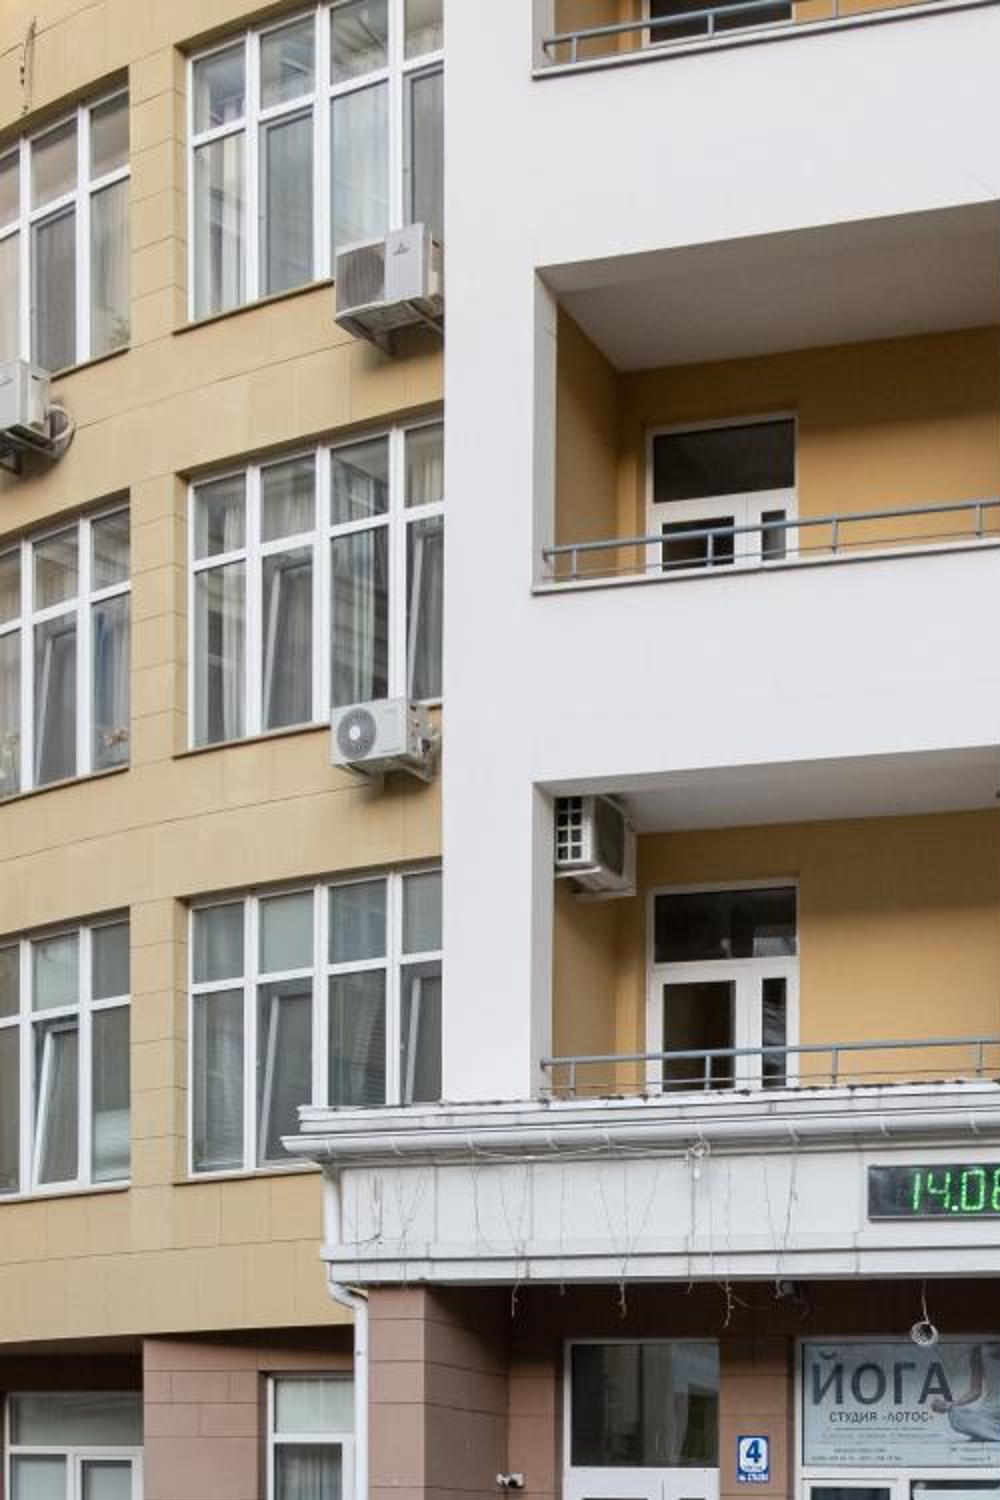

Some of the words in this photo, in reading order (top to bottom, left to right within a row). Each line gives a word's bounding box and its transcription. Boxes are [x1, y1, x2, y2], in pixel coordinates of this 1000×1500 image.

[811, 1351, 953, 1405] ЙОГА
[828, 1410, 878, 1424] СТУДИЯ
[745, 1439, 763, 1464] 4
